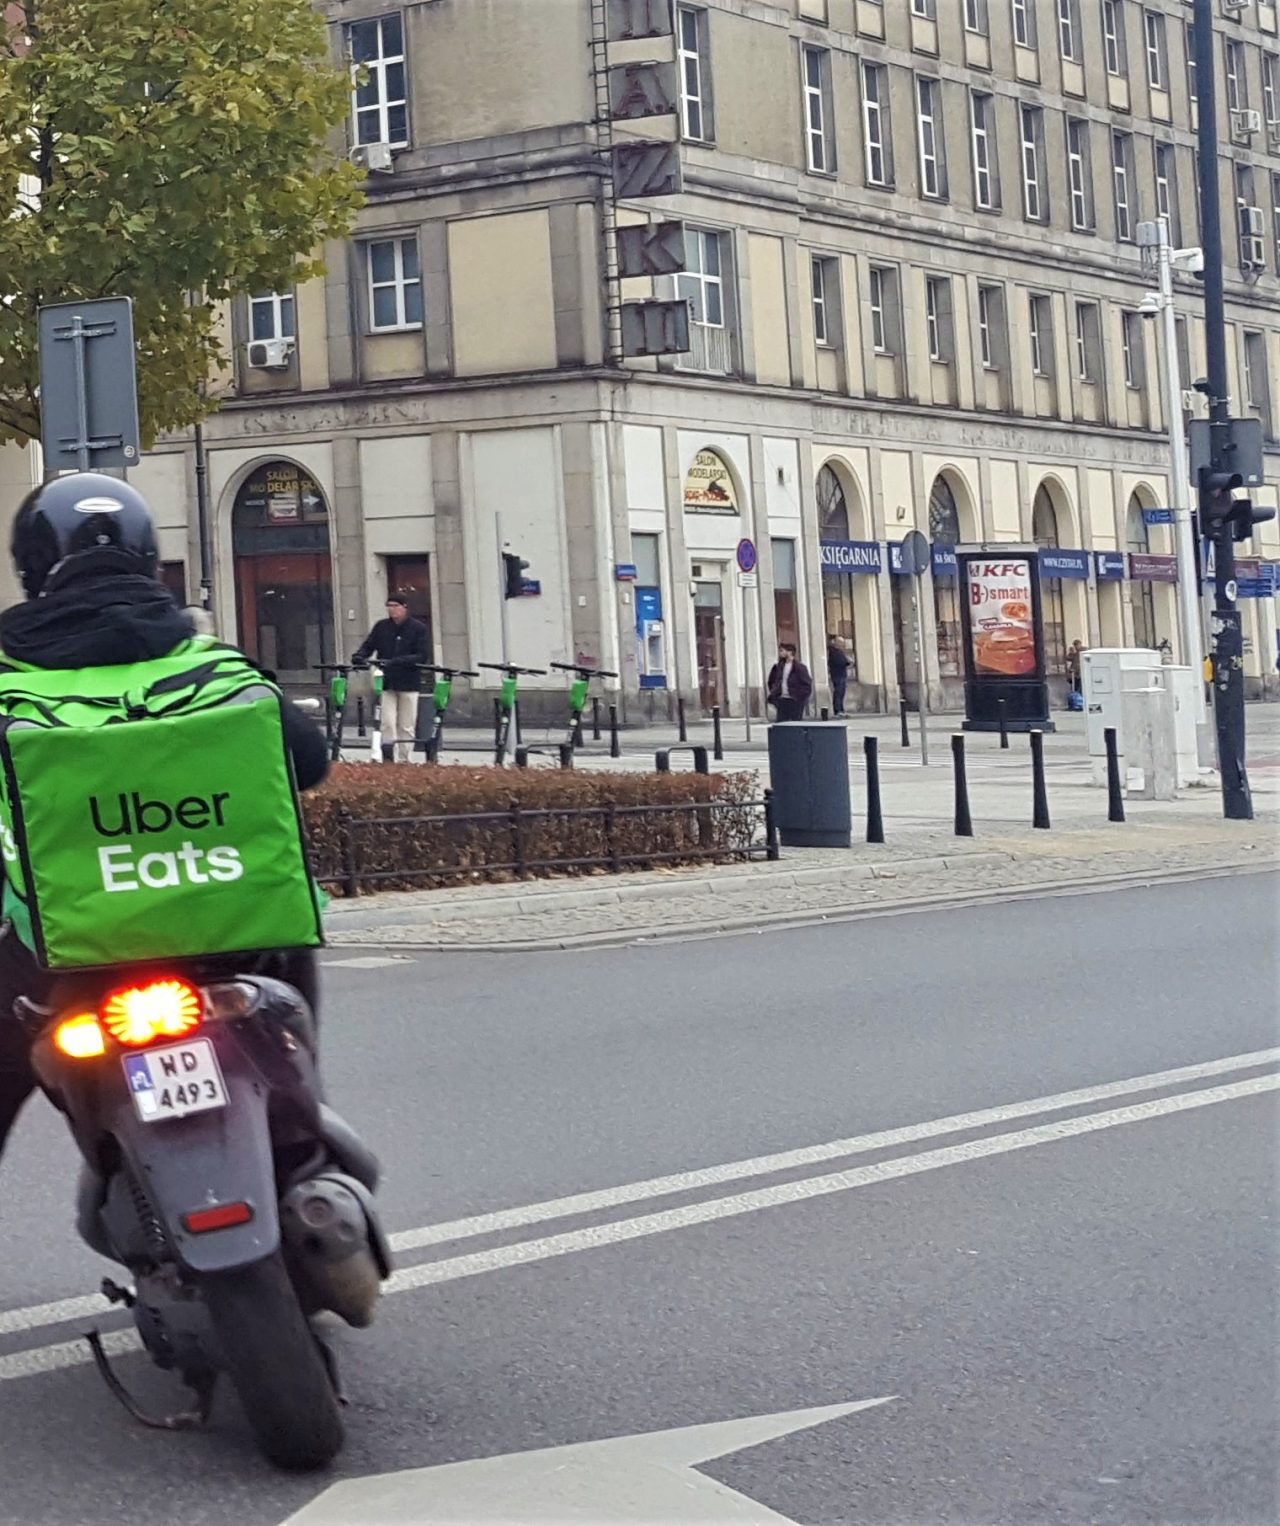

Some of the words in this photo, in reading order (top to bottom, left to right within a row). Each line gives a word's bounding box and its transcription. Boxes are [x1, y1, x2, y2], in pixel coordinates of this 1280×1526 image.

[696, 455, 717, 466] SALON
[266, 471, 298, 480] SALON
[820, 545, 880, 569] KSIĘGARNIA
[983, 564, 1026, 577] KFC
[88, 791, 230, 837] Uber
[97, 840, 244, 893] Eats
[159, 1051, 197, 1077] WD
[161, 1079, 217, 1109] 4493
